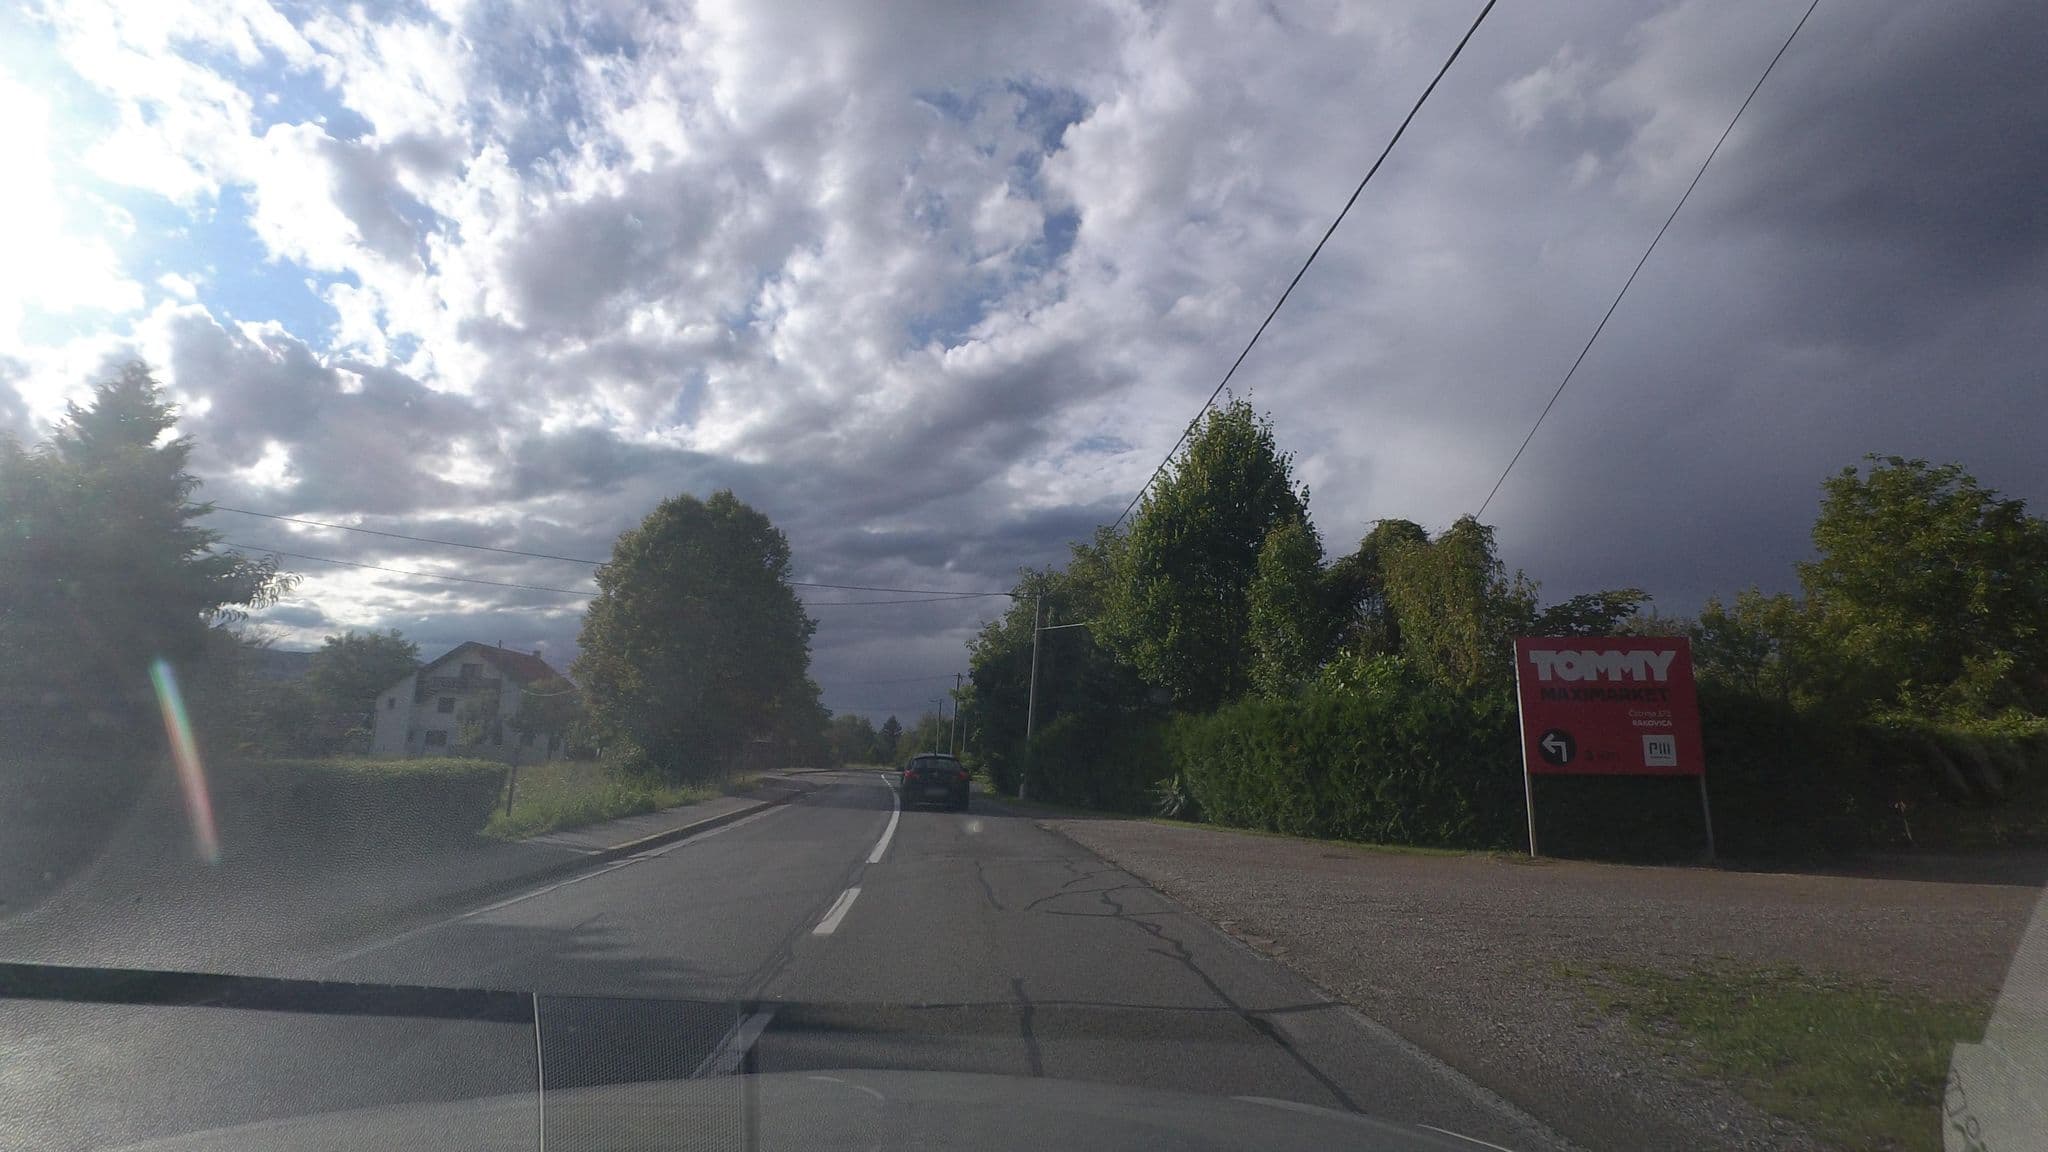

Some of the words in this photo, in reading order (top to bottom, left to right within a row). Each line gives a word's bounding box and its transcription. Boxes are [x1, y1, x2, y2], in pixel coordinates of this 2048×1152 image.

[1529, 650, 1676, 681] TOMMY
[1541, 687, 1670, 703] MAXIMARKET
[1632, 719, 1673, 727] RAKOVICA
